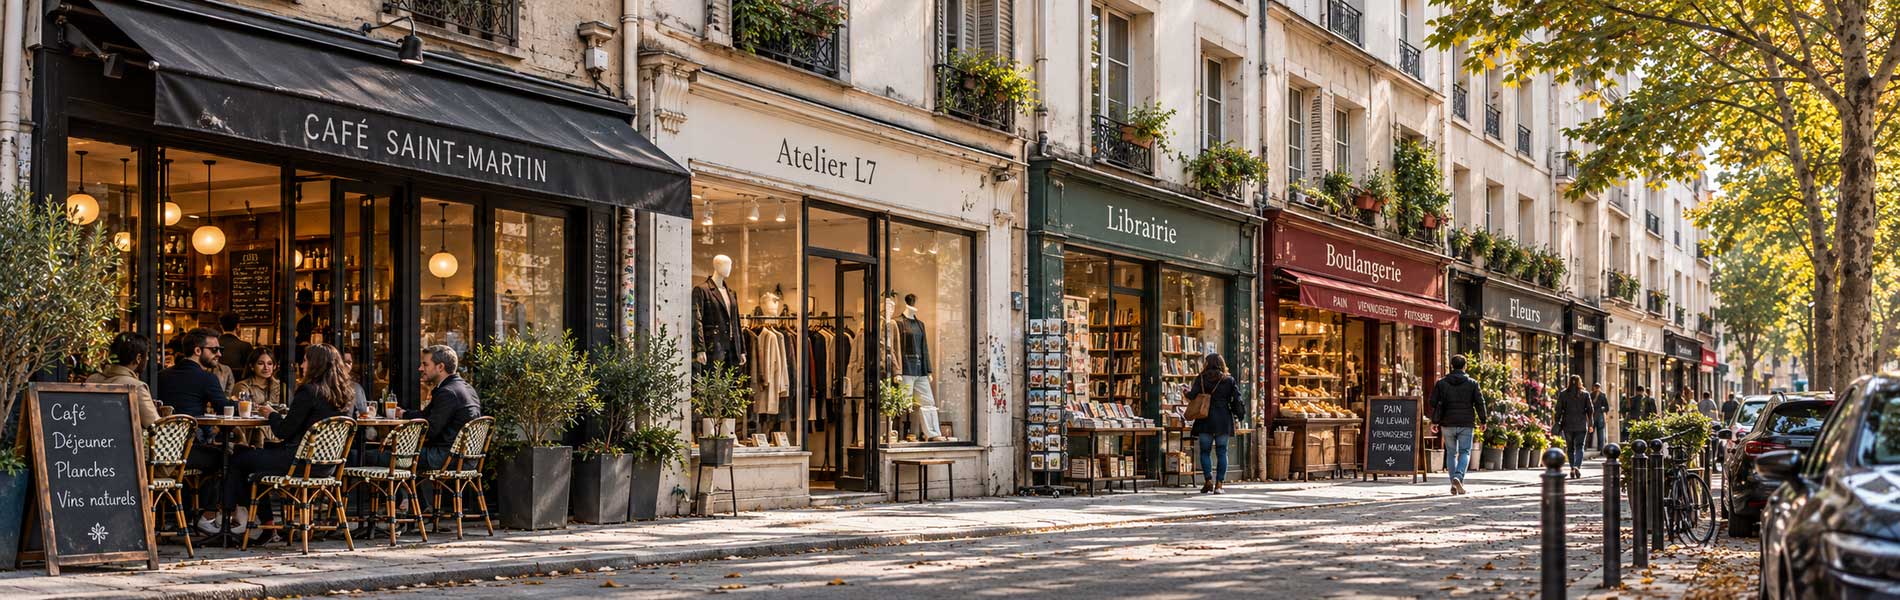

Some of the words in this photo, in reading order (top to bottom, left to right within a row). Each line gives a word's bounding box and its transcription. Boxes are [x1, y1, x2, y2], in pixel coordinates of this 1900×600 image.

[304, 113, 369, 150] CAFÉ
[386, 129, 547, 183] SAINT-MARTIN
[776, 137, 848, 178] Atelier
[855, 156, 876, 185] L7
[1106, 204, 1177, 244] Librairie
[1326, 243, 1401, 283] Boulangerie
[1332, 295, 1348, 309] PAIN
[1509, 297, 1541, 323] Fleurs
[51, 403, 87, 426] Café
[1383, 404, 1402, 414] PAIN
[1374, 416, 1385, 425] AU
[1386, 416, 1410, 425] LEVAIN
[1371, 442, 1386, 451] FAIT
[54, 460, 116, 479] Planches
[56, 490, 85, 509] Vins
[89, 490, 136, 507] naturels
